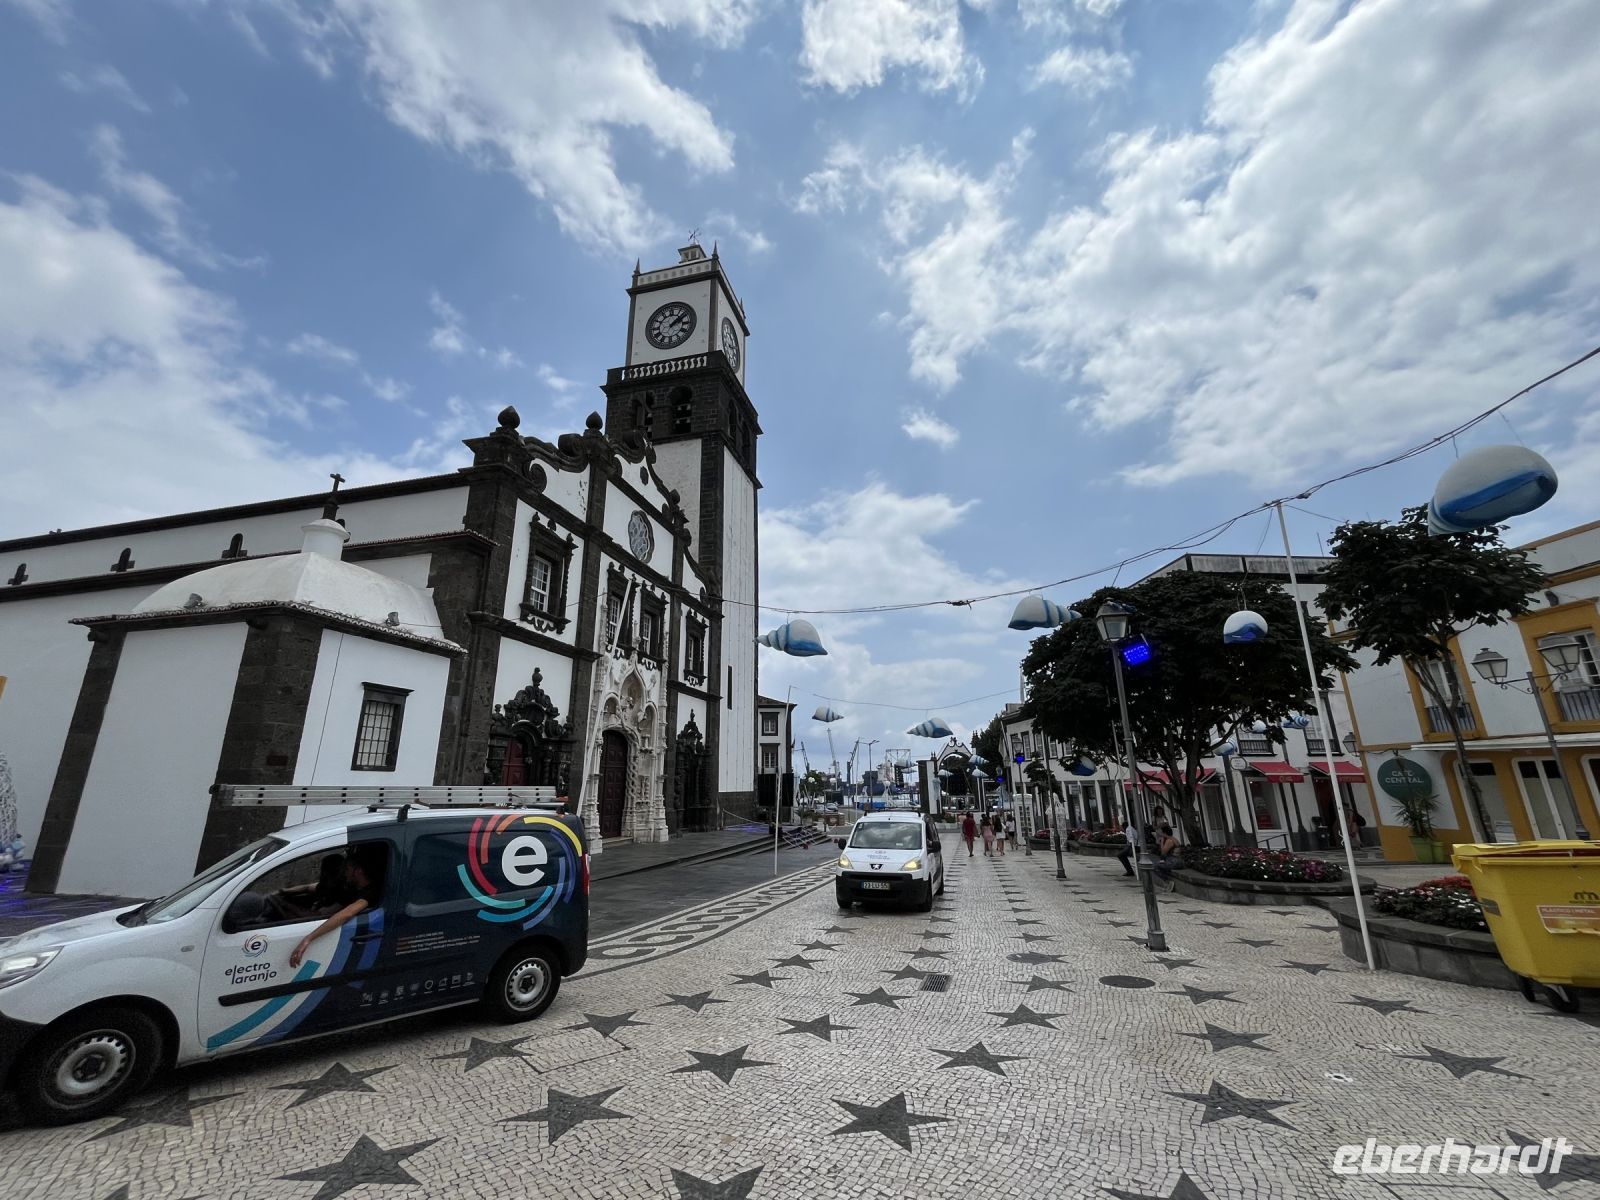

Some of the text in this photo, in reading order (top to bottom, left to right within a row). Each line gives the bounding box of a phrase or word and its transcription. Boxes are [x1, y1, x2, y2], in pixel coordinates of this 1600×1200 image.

[502, 835, 548, 887] e
[251, 941, 262, 950] e
[225, 962, 271, 980] electro
[231, 968, 277, 984] laranjo
